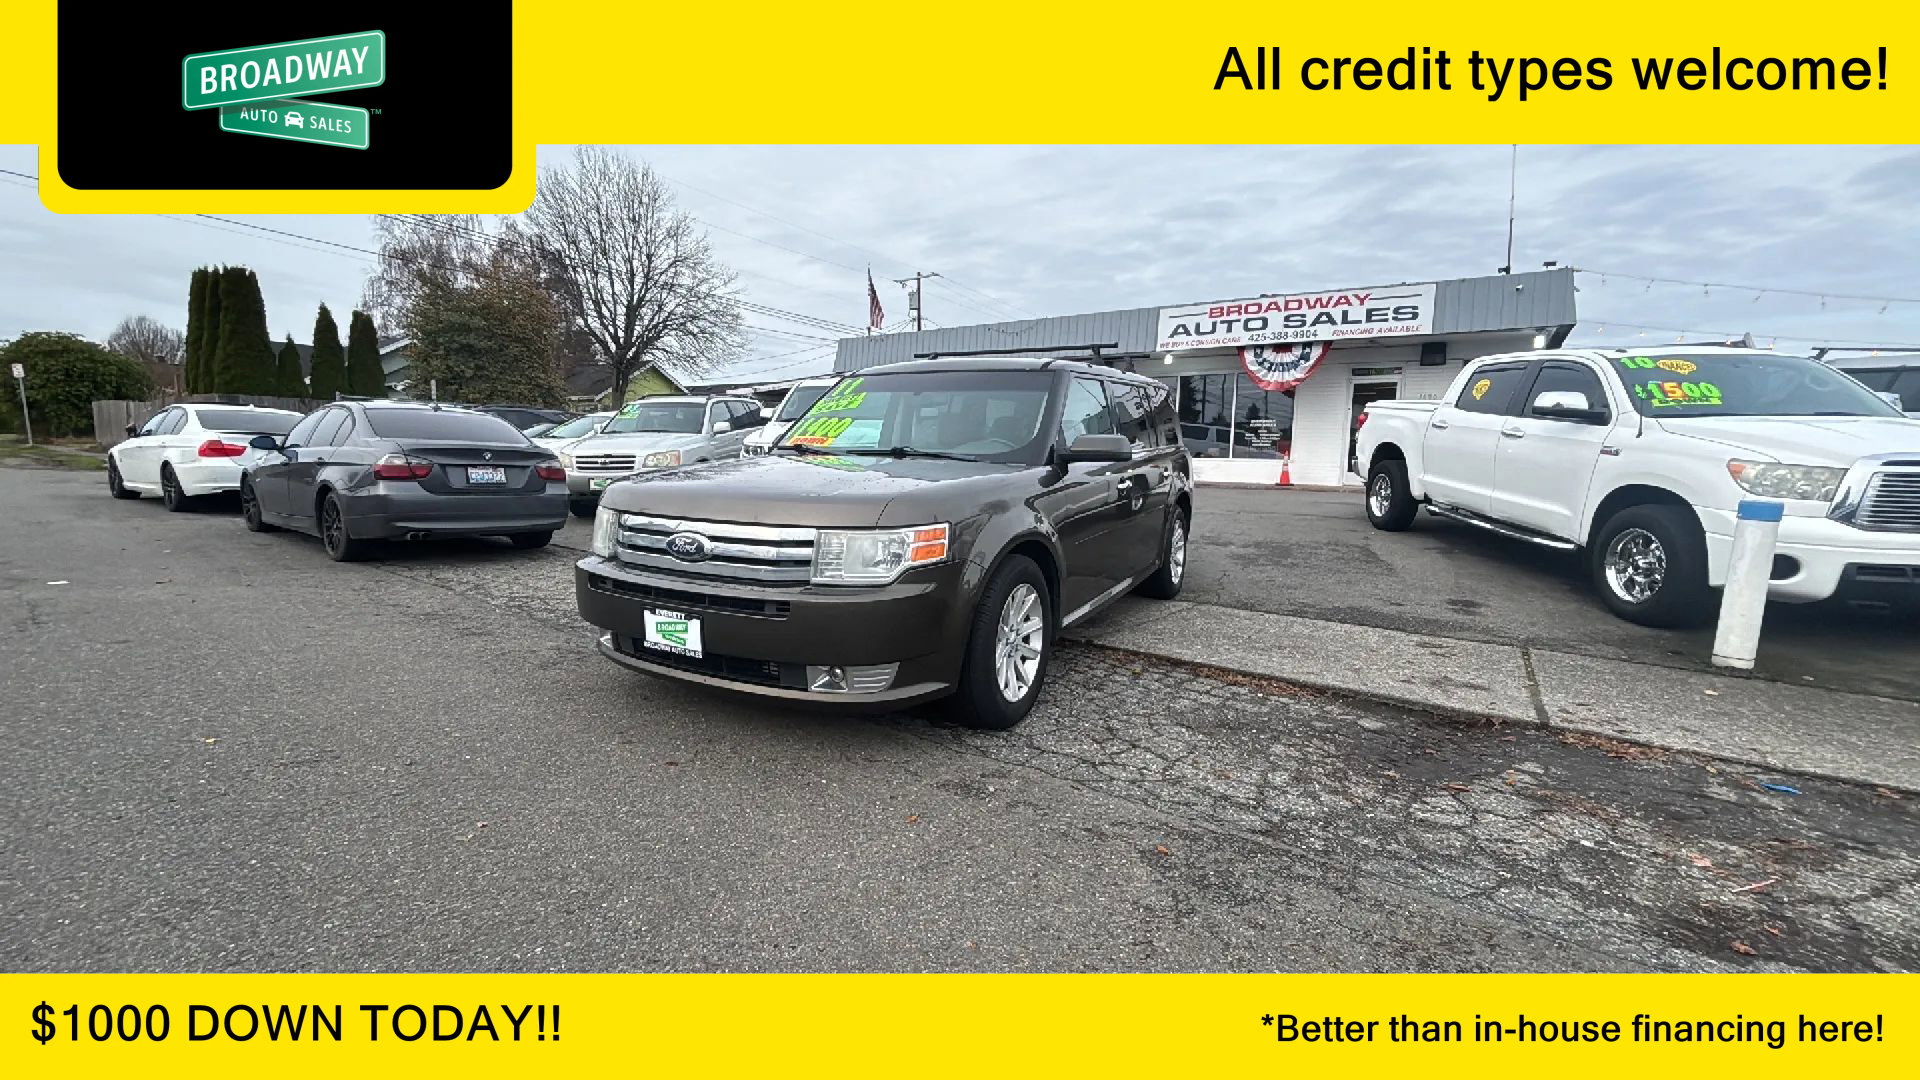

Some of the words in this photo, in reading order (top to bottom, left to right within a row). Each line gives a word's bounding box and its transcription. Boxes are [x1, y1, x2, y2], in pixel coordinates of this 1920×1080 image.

[1208, 293, 1372, 319] BROADWAY
[1168, 316, 1269, 338] AUTO
[1283, 306, 1419, 329] SALES
[1376, 325, 1422, 335] AVAILABLE
[671, 537, 699, 553] Ford
[657, 623, 687, 631] BROADWAY
[672, 647, 685, 655] AUTO
[685, 649, 703, 658] SALES
